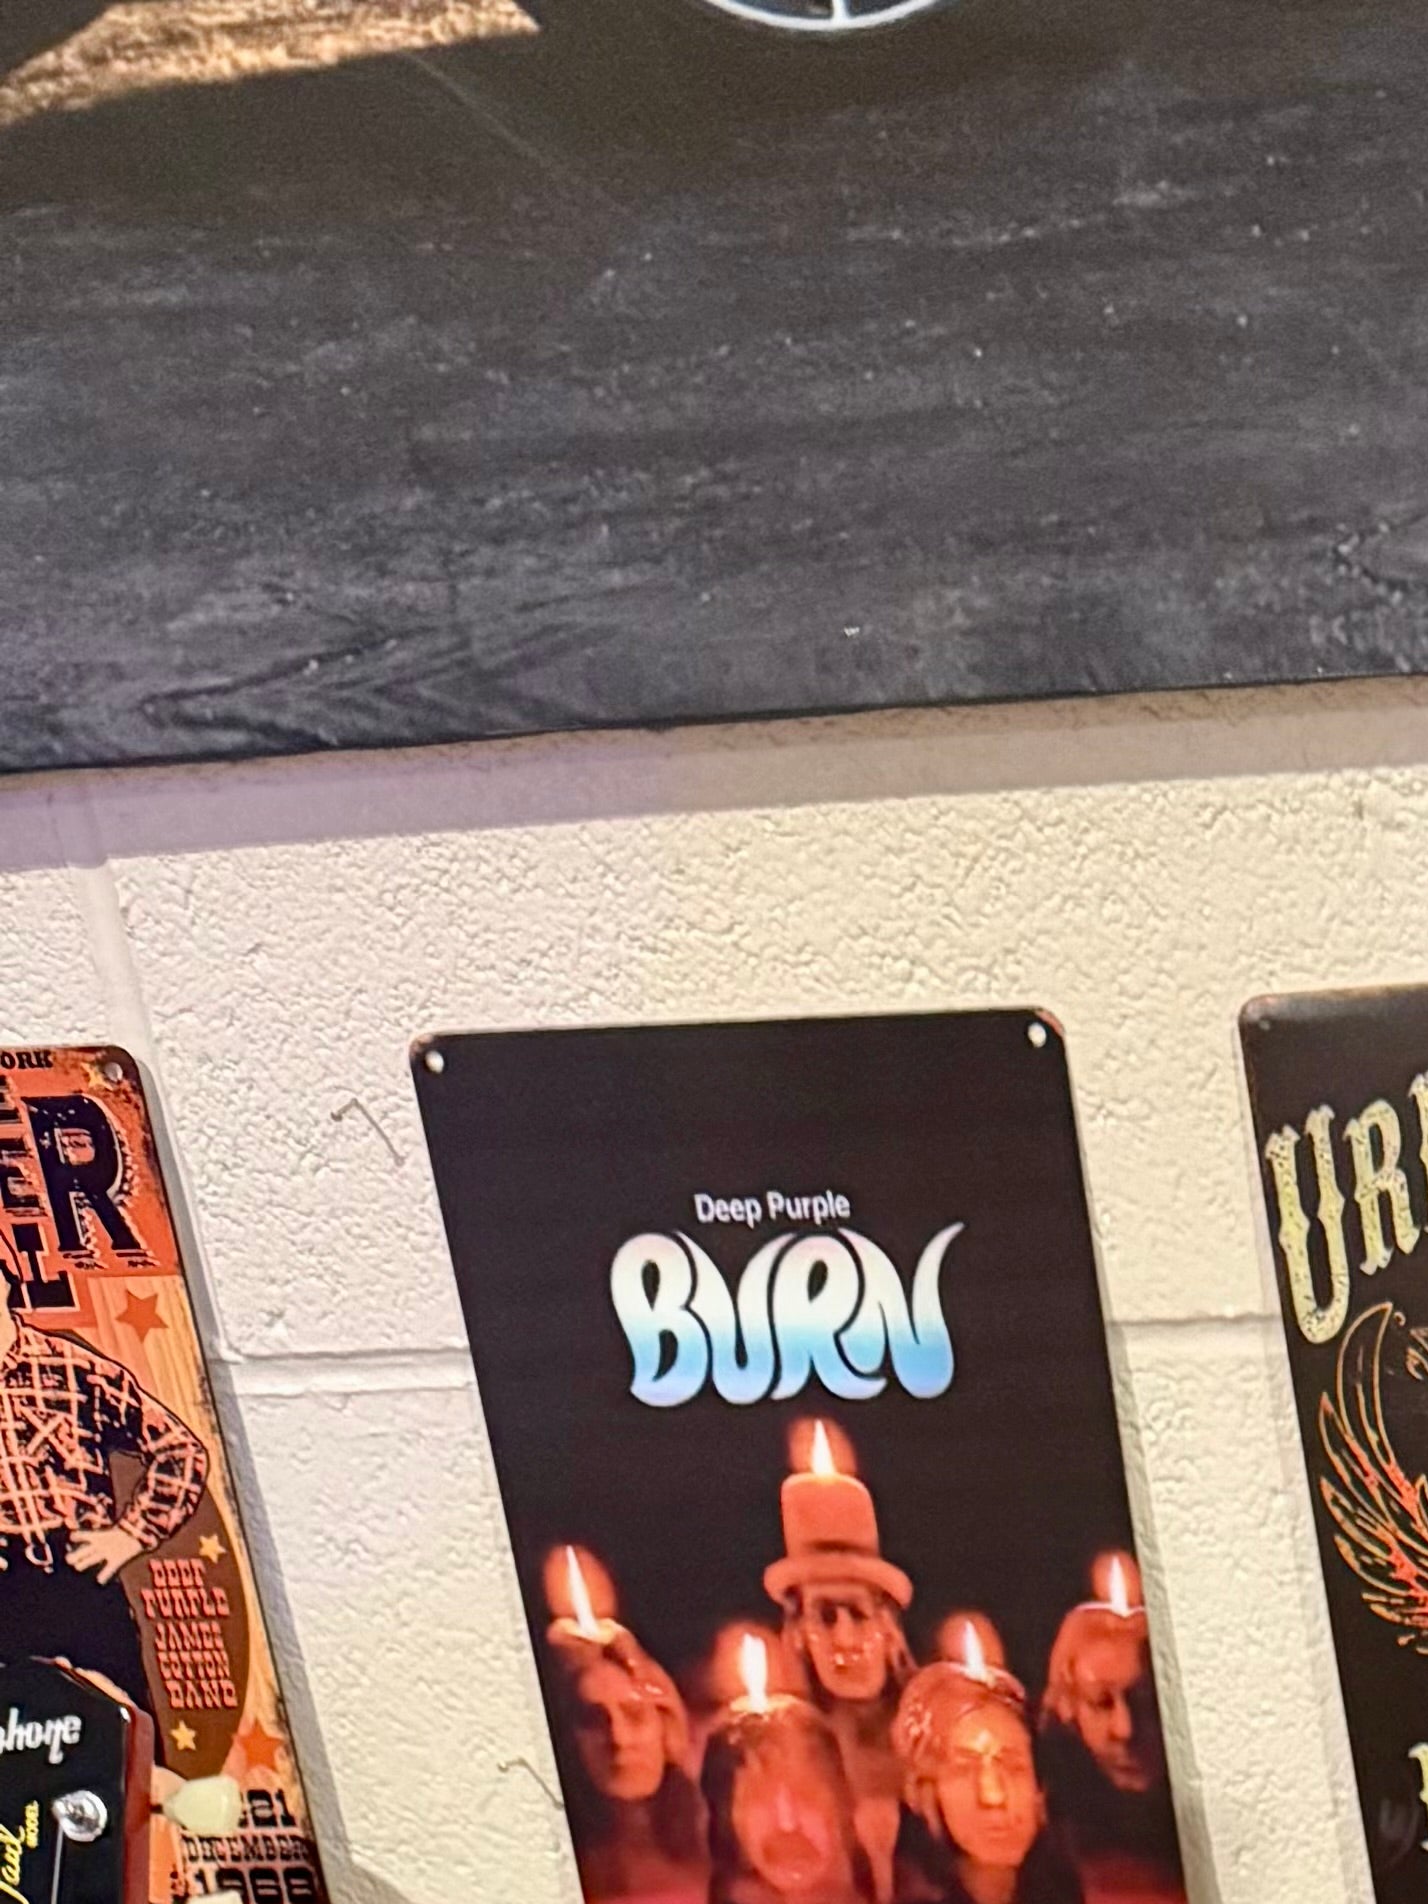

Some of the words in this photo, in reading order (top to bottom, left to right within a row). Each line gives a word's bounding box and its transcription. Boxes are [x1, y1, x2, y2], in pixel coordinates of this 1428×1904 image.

[694, 1193, 762, 1229] Deep
[766, 1190, 851, 1225] Purple
[610, 1221, 965, 1408] BURN
[182, 1833, 310, 1864] DECEMBER
